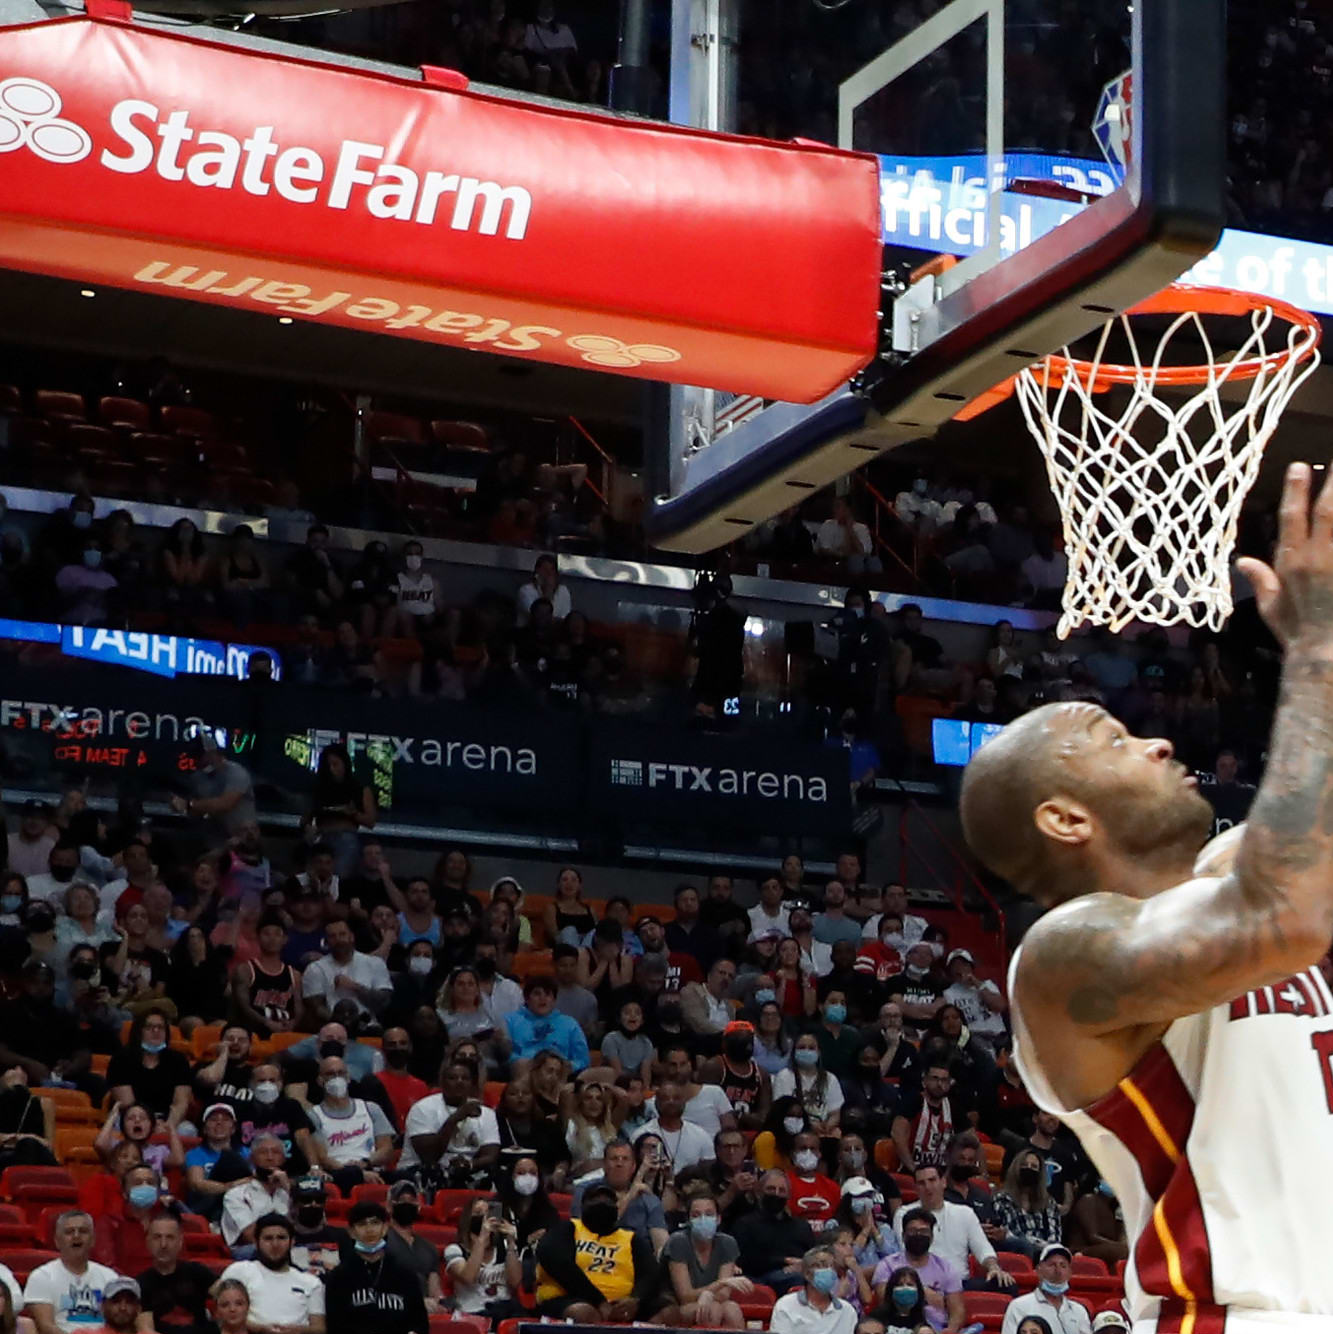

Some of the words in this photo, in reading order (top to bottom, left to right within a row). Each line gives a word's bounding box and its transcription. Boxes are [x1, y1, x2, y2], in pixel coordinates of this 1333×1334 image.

[102, 99, 323, 203] State
[329, 140, 532, 241] Farm
[1236, 246, 1296, 296] of
[421, 737, 538, 776] arena
[649, 763, 712, 792] FTX
[718, 766, 829, 802] arena
